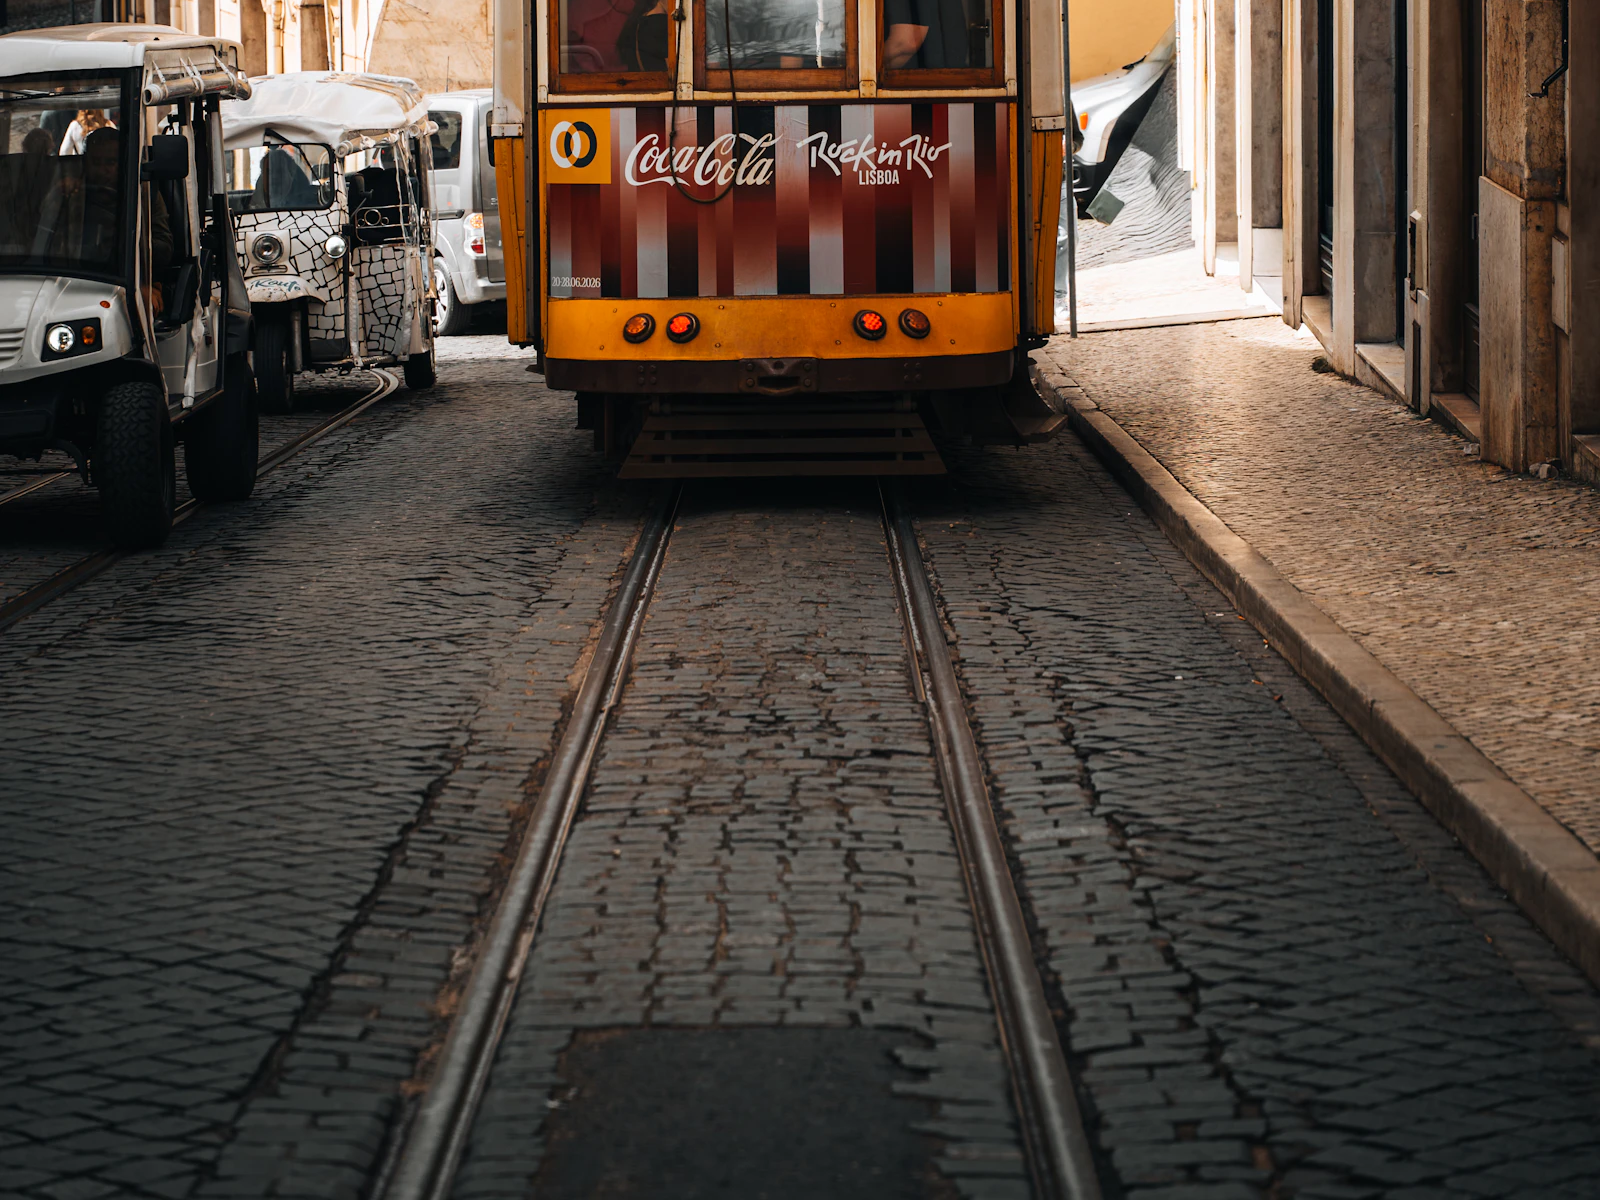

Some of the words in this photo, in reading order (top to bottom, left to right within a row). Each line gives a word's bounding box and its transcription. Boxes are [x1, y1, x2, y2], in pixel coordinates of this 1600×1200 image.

[624, 133, 784, 187] Coca-Cola
[796, 131, 877, 177] Rock
[877, 142, 902, 166] in
[899, 134, 953, 179] Rio
[858, 169, 900, 186] LISBOA
